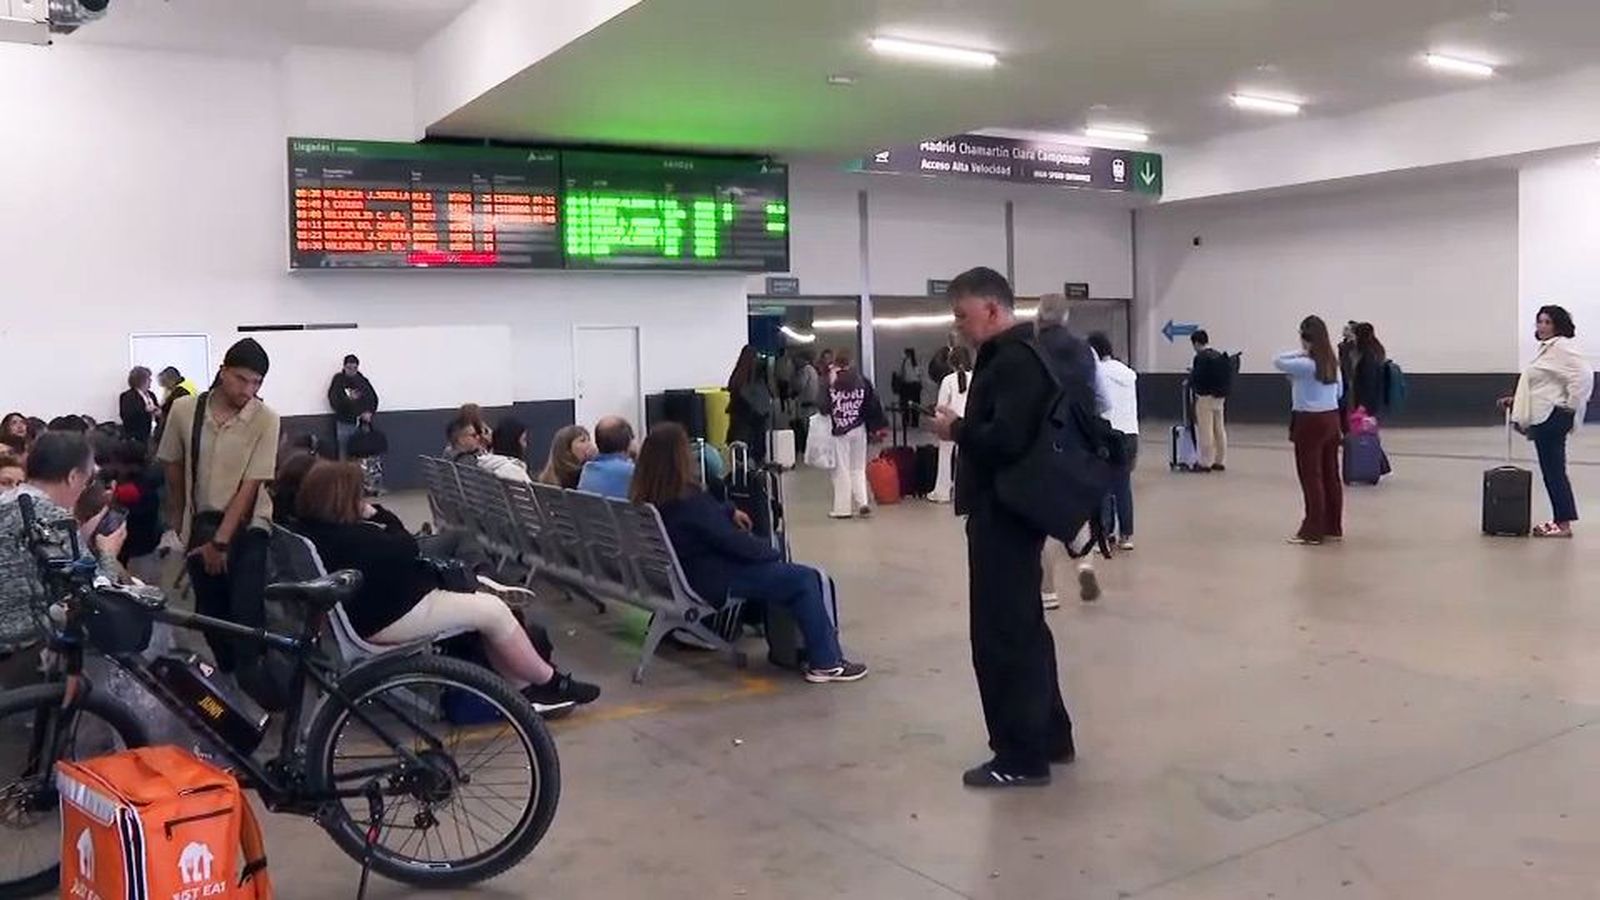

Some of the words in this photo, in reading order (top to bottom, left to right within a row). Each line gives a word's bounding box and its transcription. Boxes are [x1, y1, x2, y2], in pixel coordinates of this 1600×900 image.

[293, 142, 330, 153] Llegadas
[920, 140, 956, 153] Madrid
[1012, 147, 1035, 161] Clara
[1037, 149, 1091, 166] Campoamor
[920, 158, 951, 171] Acceso
[952, 161, 970, 173] Alta
[971, 162, 1012, 176] Velocidad
[202, 880, 227, 897] EAT
